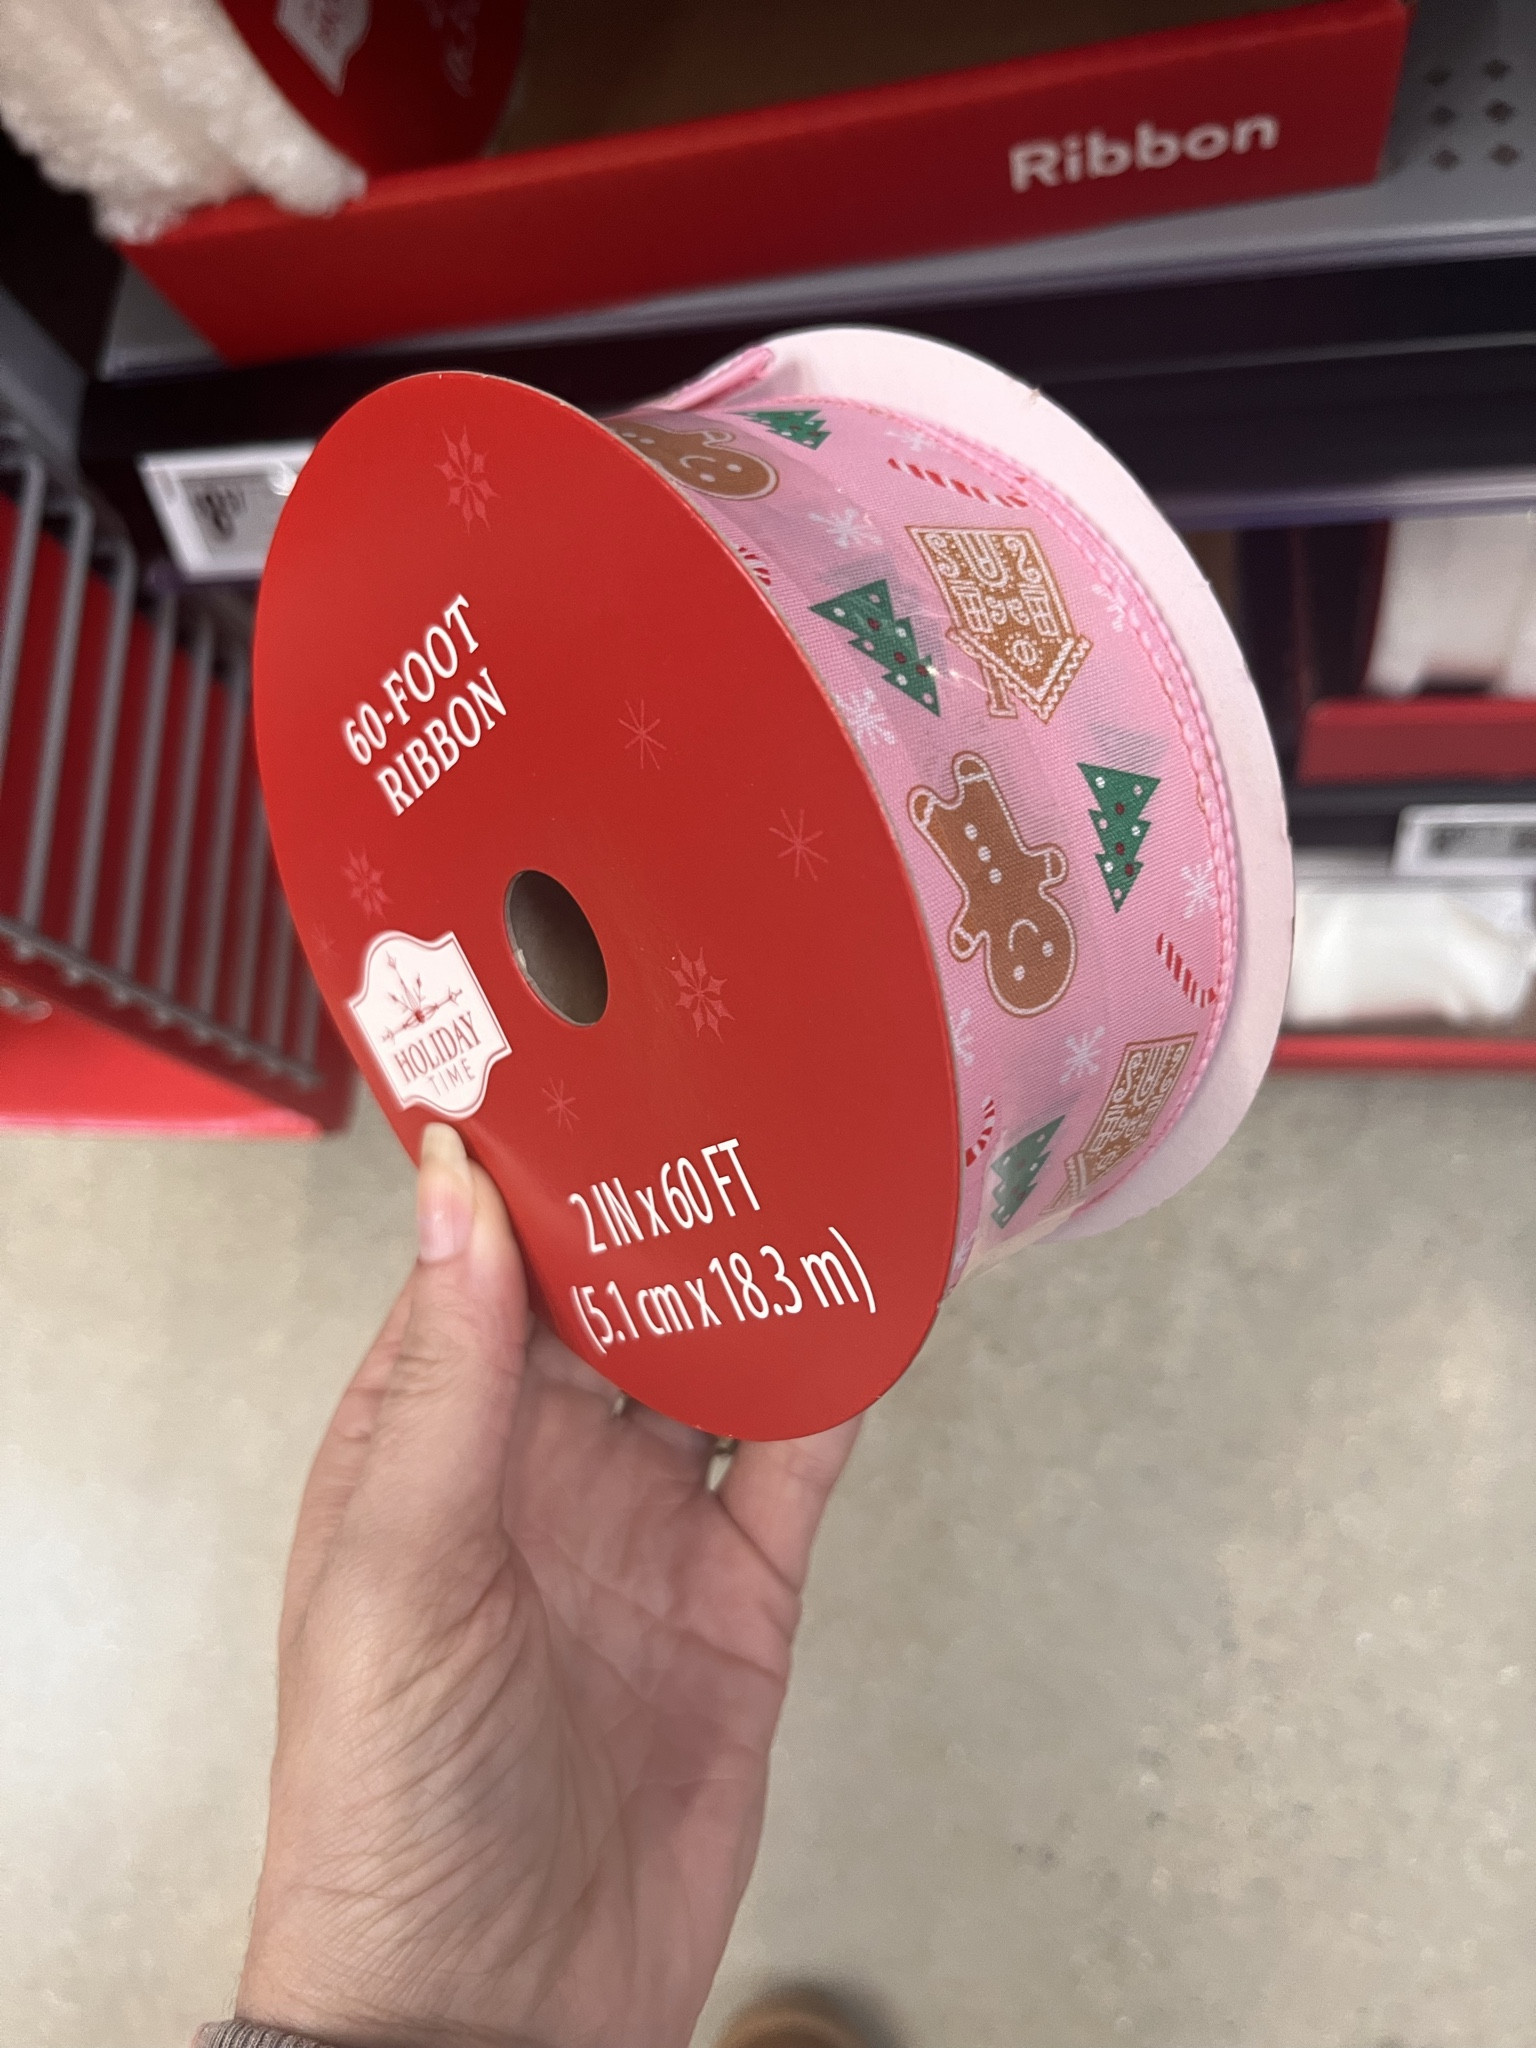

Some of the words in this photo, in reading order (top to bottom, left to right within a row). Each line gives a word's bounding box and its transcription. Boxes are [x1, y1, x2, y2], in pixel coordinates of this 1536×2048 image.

[1009, 115, 1279, 192] Ribbon
[343, 594, 479, 766] 60-FOOT
[376, 667, 507, 816] RIBBON
[394, 1012, 481, 1083] HOLIDAY
[428, 1058, 476, 1096] TIME
[569, 1193, 607, 1253] 2
[590, 1177, 644, 1247] IN
[633, 1186, 671, 1237] x
[660, 1157, 713, 1229] 60
[701, 1138, 760, 1217] FT
[570, 1280, 639, 1355] (5.1
[636, 1283, 694, 1335] cm
[685, 1278, 722, 1327] x
[709, 1245, 803, 1322] 18.3
[799, 1226, 876, 1313] m)
